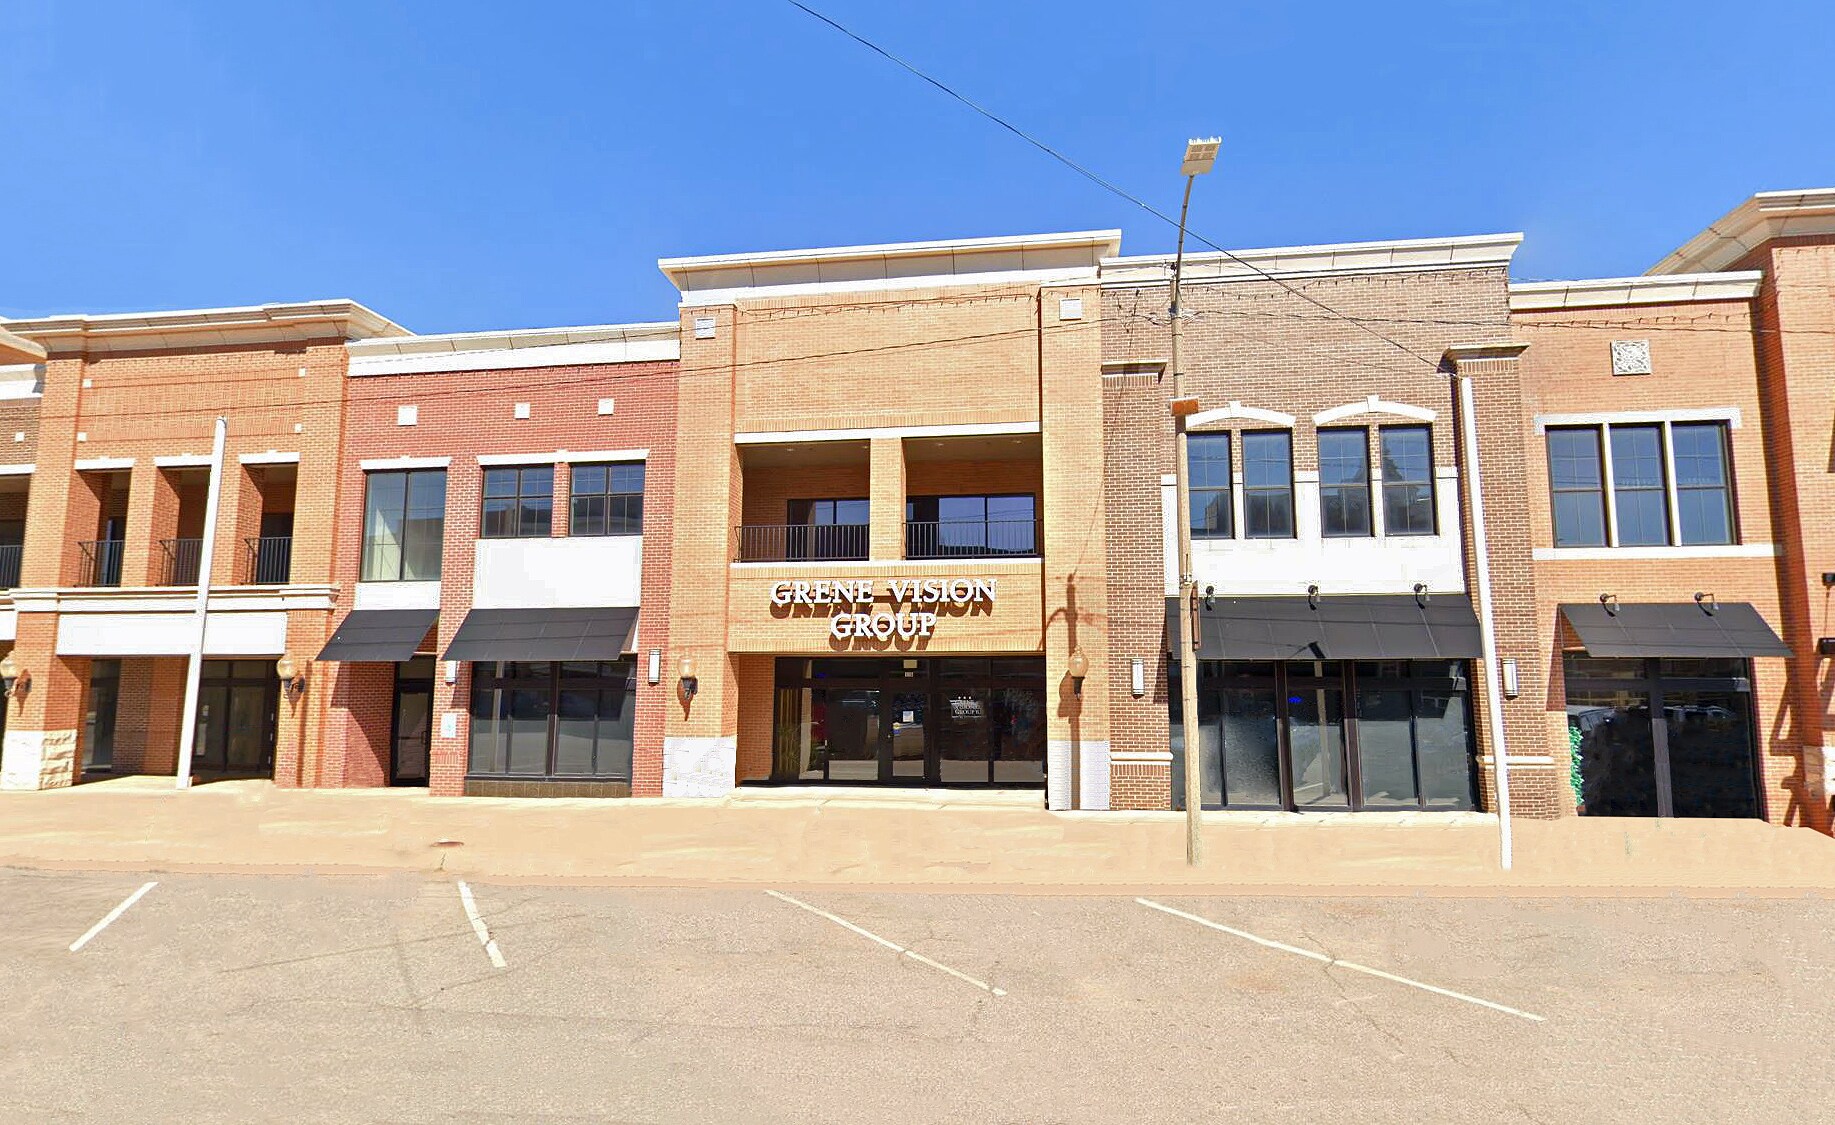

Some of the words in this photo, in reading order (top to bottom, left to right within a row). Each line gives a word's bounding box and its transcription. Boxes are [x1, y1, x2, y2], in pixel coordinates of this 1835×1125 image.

[770, 580, 874, 604] GRENE
[888, 579, 997, 603] VISION
[831, 612, 937, 637] GROUP
